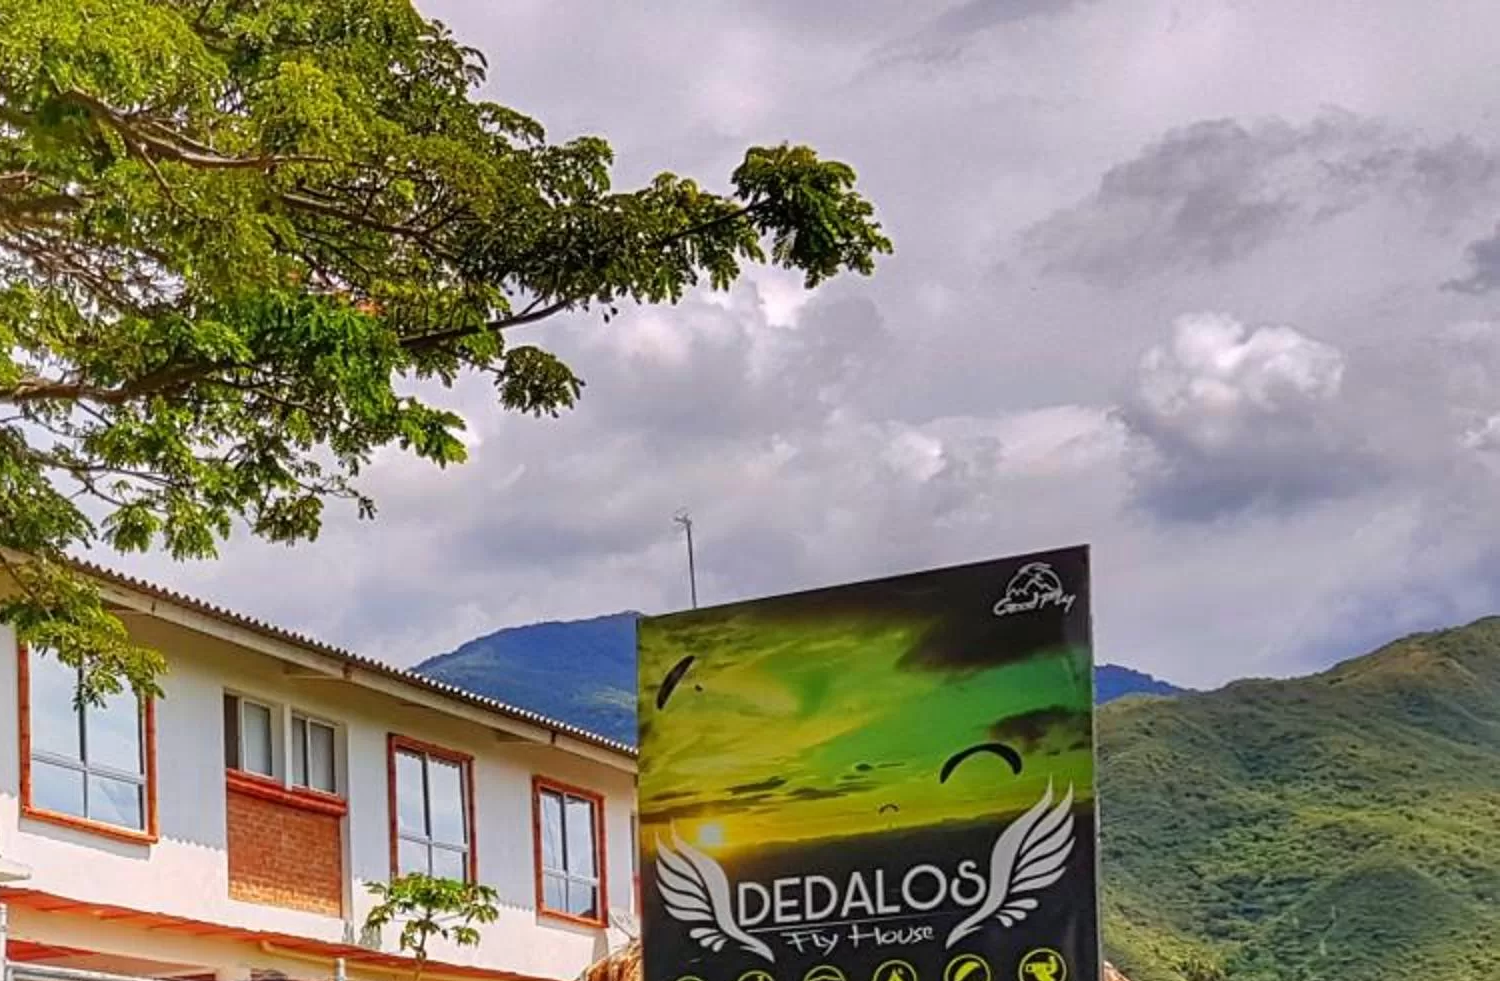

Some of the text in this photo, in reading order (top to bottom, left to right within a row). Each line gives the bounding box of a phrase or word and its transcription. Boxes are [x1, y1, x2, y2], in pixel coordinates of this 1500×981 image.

[738, 860, 987, 926] DEDALOS
[781, 923, 934, 956] Fly House
